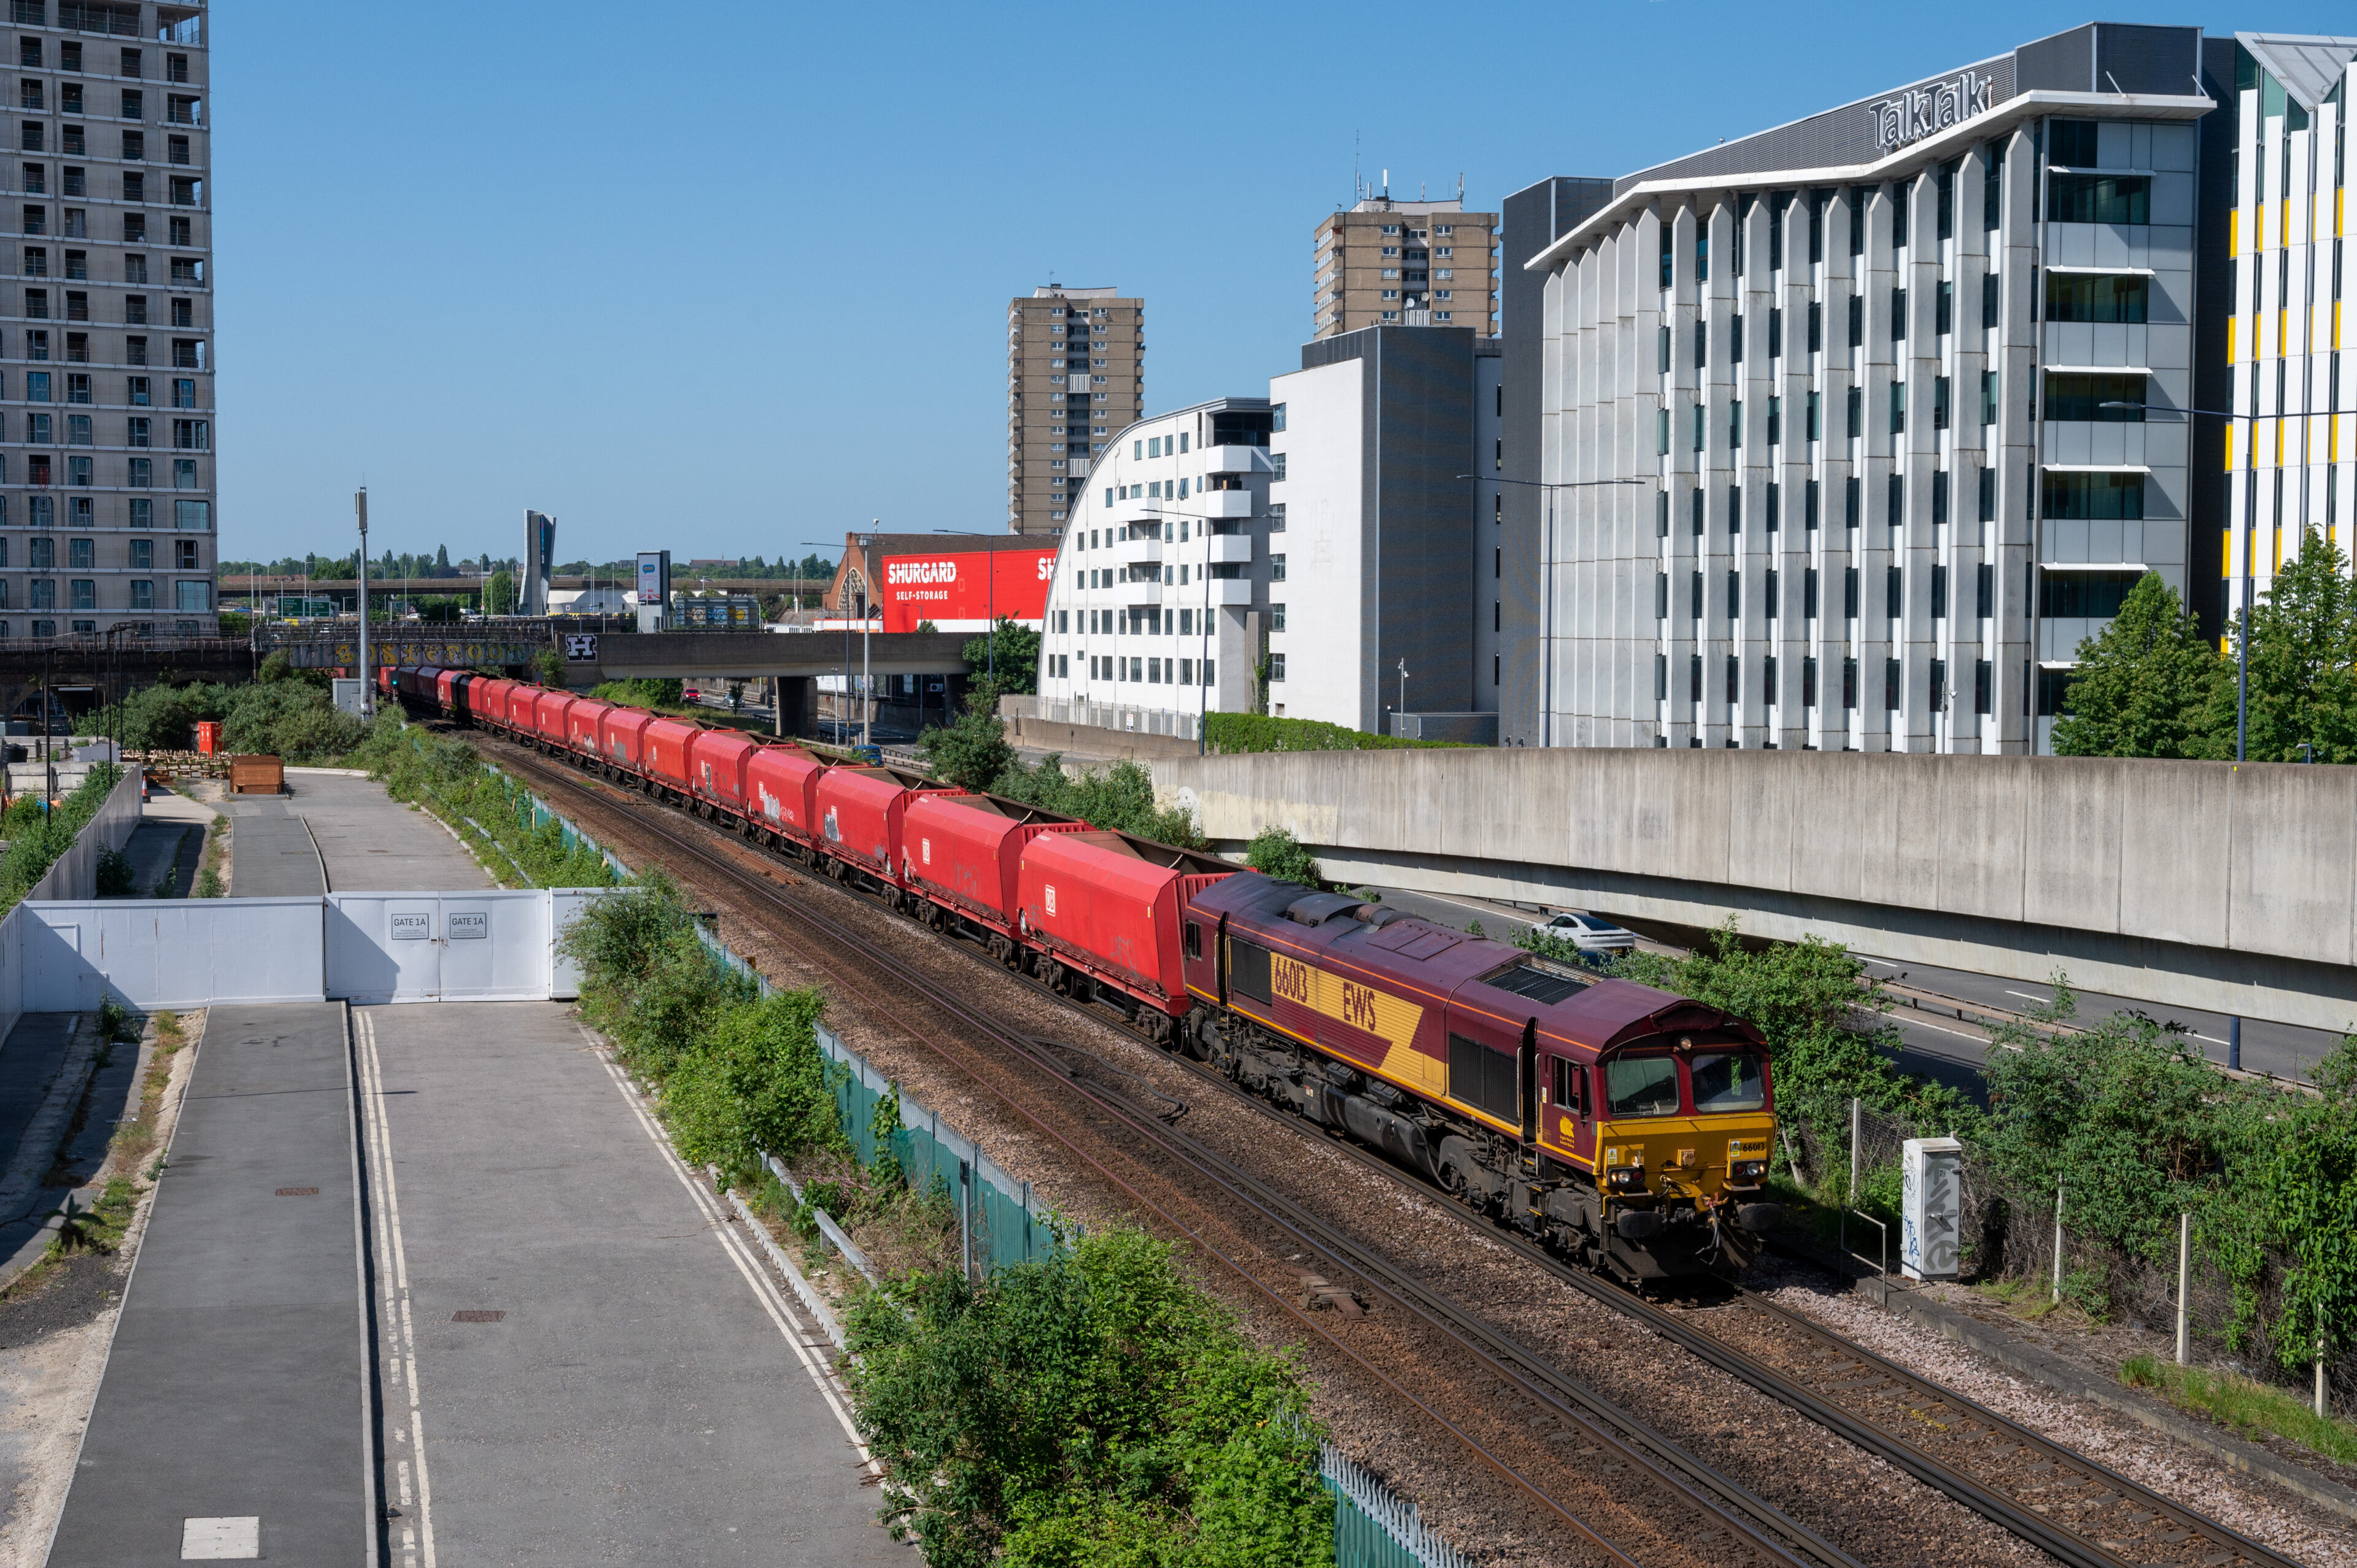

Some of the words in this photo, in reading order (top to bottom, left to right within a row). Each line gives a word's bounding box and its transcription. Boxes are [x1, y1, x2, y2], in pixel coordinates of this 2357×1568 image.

[1869, 71, 1986, 149] TalkTalk
[888, 562, 956, 584] SHURGARD
[897, 591, 948, 600] SELF-STORAGE
[1047, 890, 1054, 910] DB
[1275, 957, 1307, 1003] 66013
[1343, 981, 1376, 1032] EWS
[1743, 1142, 1765, 1152] 66013
